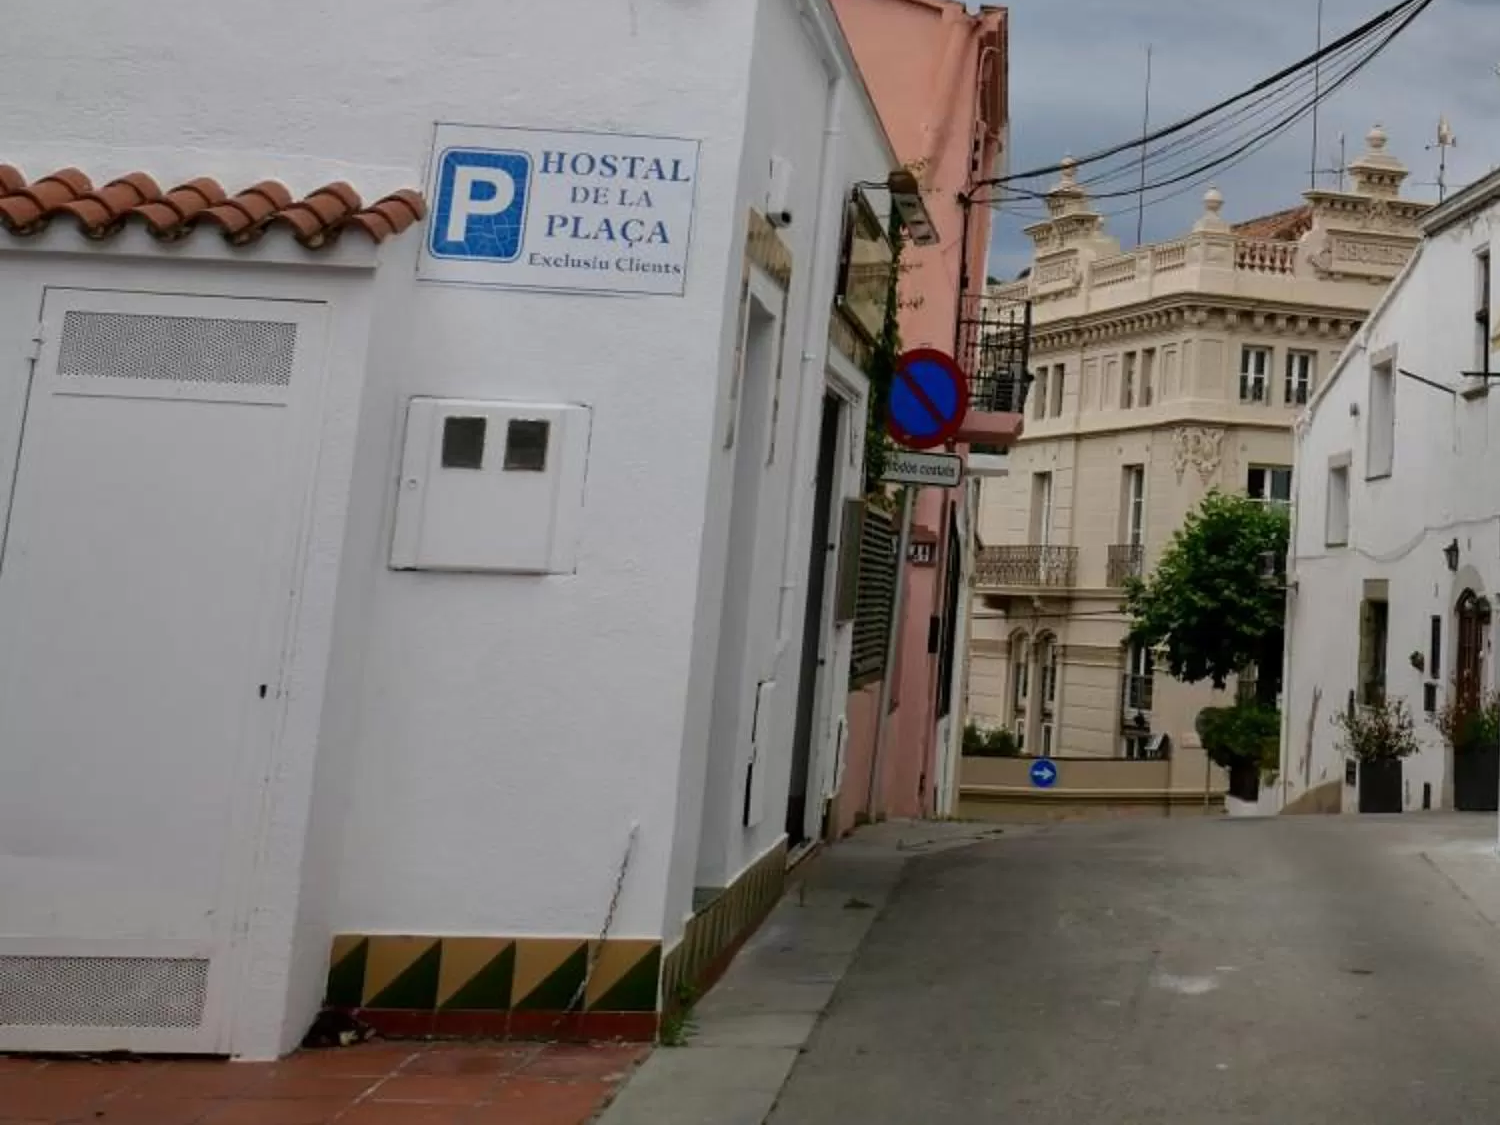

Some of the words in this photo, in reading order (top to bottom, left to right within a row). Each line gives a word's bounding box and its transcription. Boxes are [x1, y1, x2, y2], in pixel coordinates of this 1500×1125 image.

[538, 150, 691, 183] HOSTAL
[446, 164, 516, 242] P
[570, 186, 609, 205] DE
[618, 188, 655, 208] LA
[544, 214, 671, 248] PLAÇA
[528, 252, 609, 271] Exclusiu
[615, 256, 682, 275] Clients
